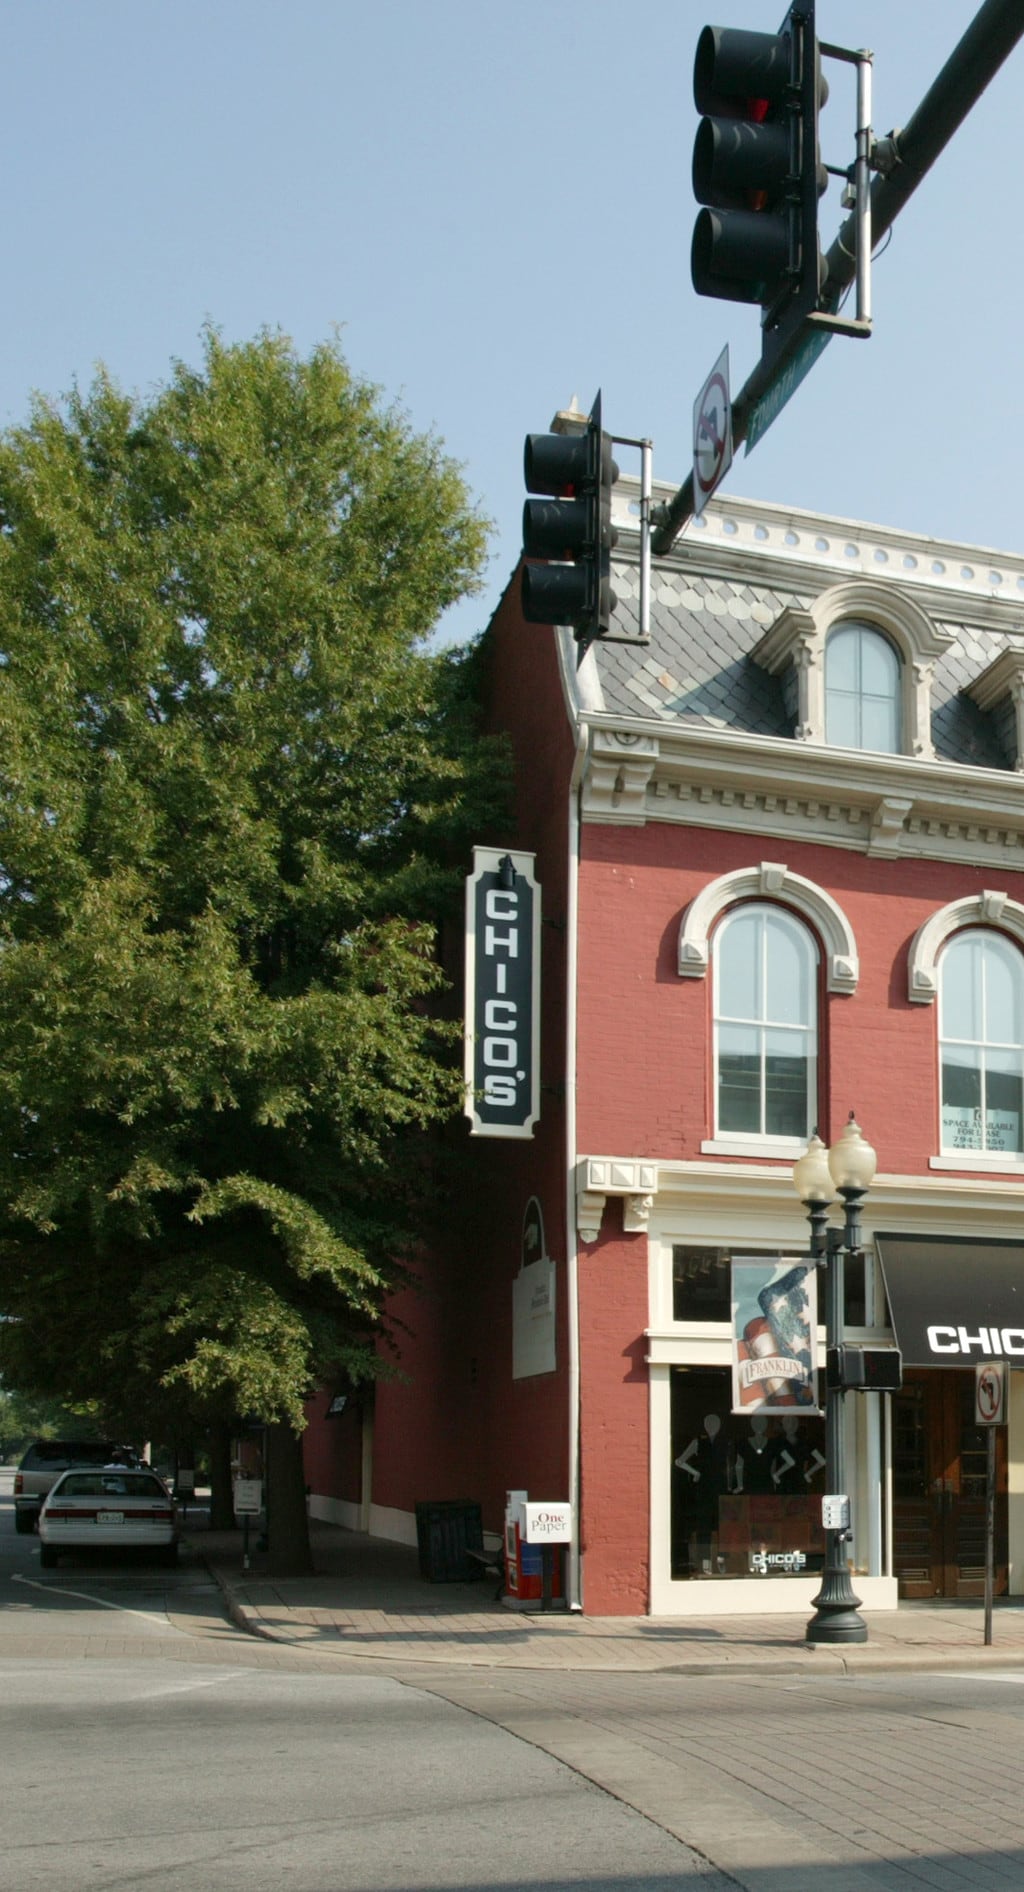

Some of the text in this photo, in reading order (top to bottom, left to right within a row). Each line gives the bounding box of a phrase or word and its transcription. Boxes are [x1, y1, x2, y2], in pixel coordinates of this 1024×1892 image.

[484, 889, 526, 1107] CHICO'S
[943, 1119, 1015, 1131] SPACE AVILABLE
[957, 1128, 1001, 1138] FOR LASE
[750, 1359, 802, 1378] FRANKLIN
[538, 1512, 564, 1523] One
[532, 1520, 566, 1533] Paper
